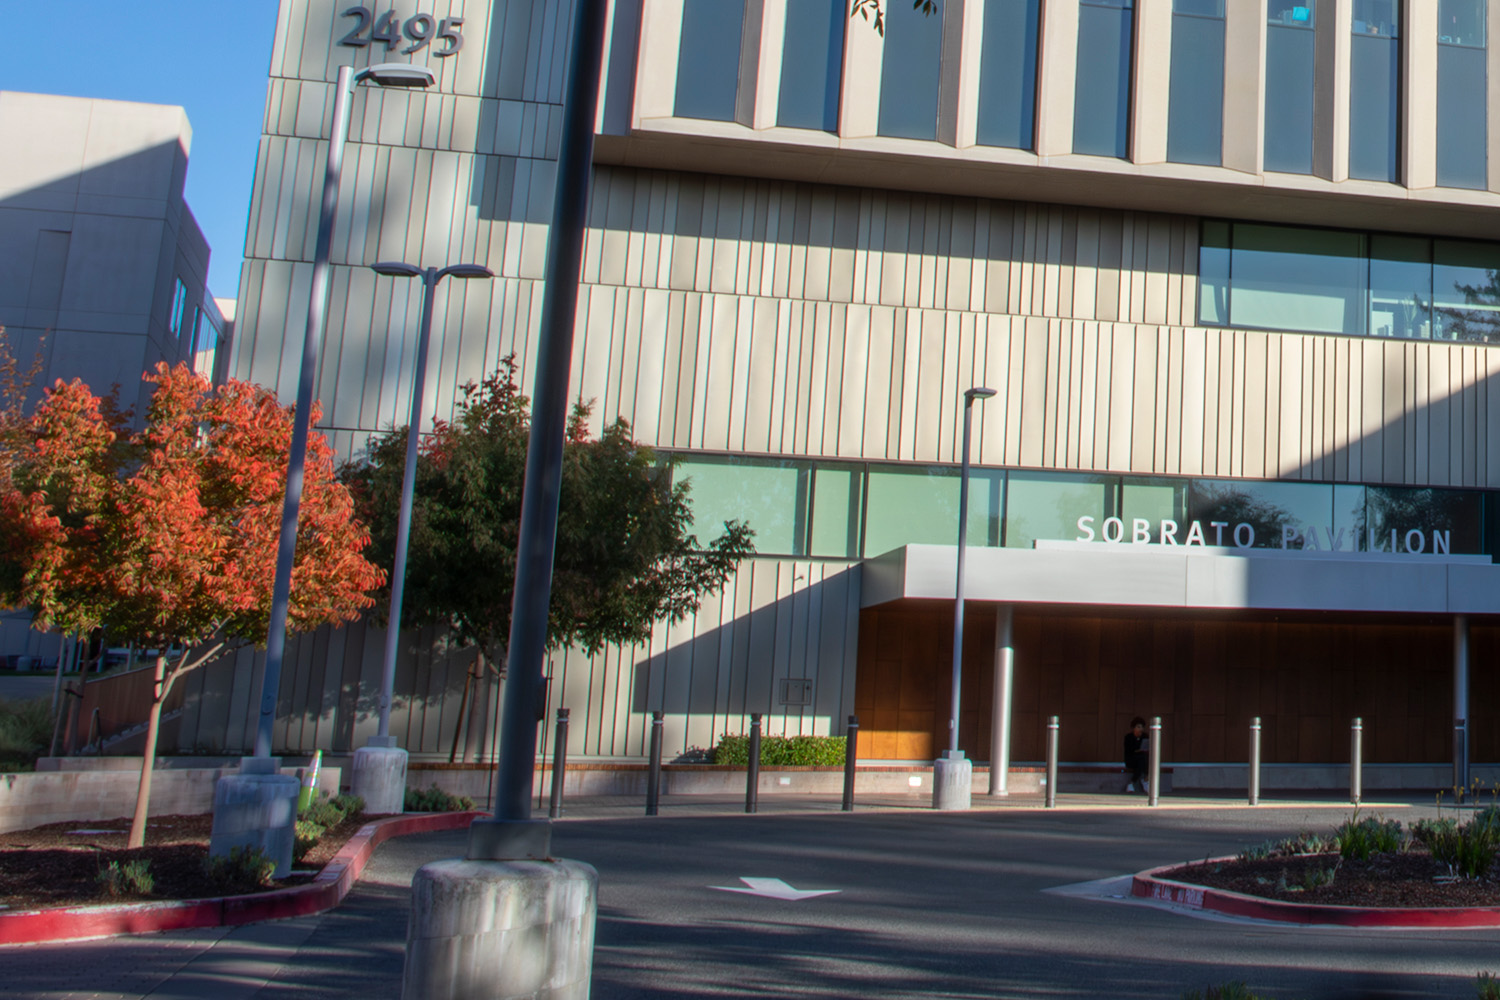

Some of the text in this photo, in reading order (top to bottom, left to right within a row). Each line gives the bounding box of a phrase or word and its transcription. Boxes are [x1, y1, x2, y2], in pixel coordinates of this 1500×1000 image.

[340, 6, 465, 57] 2495
[1076, 516, 1450, 555] SOBRATO PAVILION
